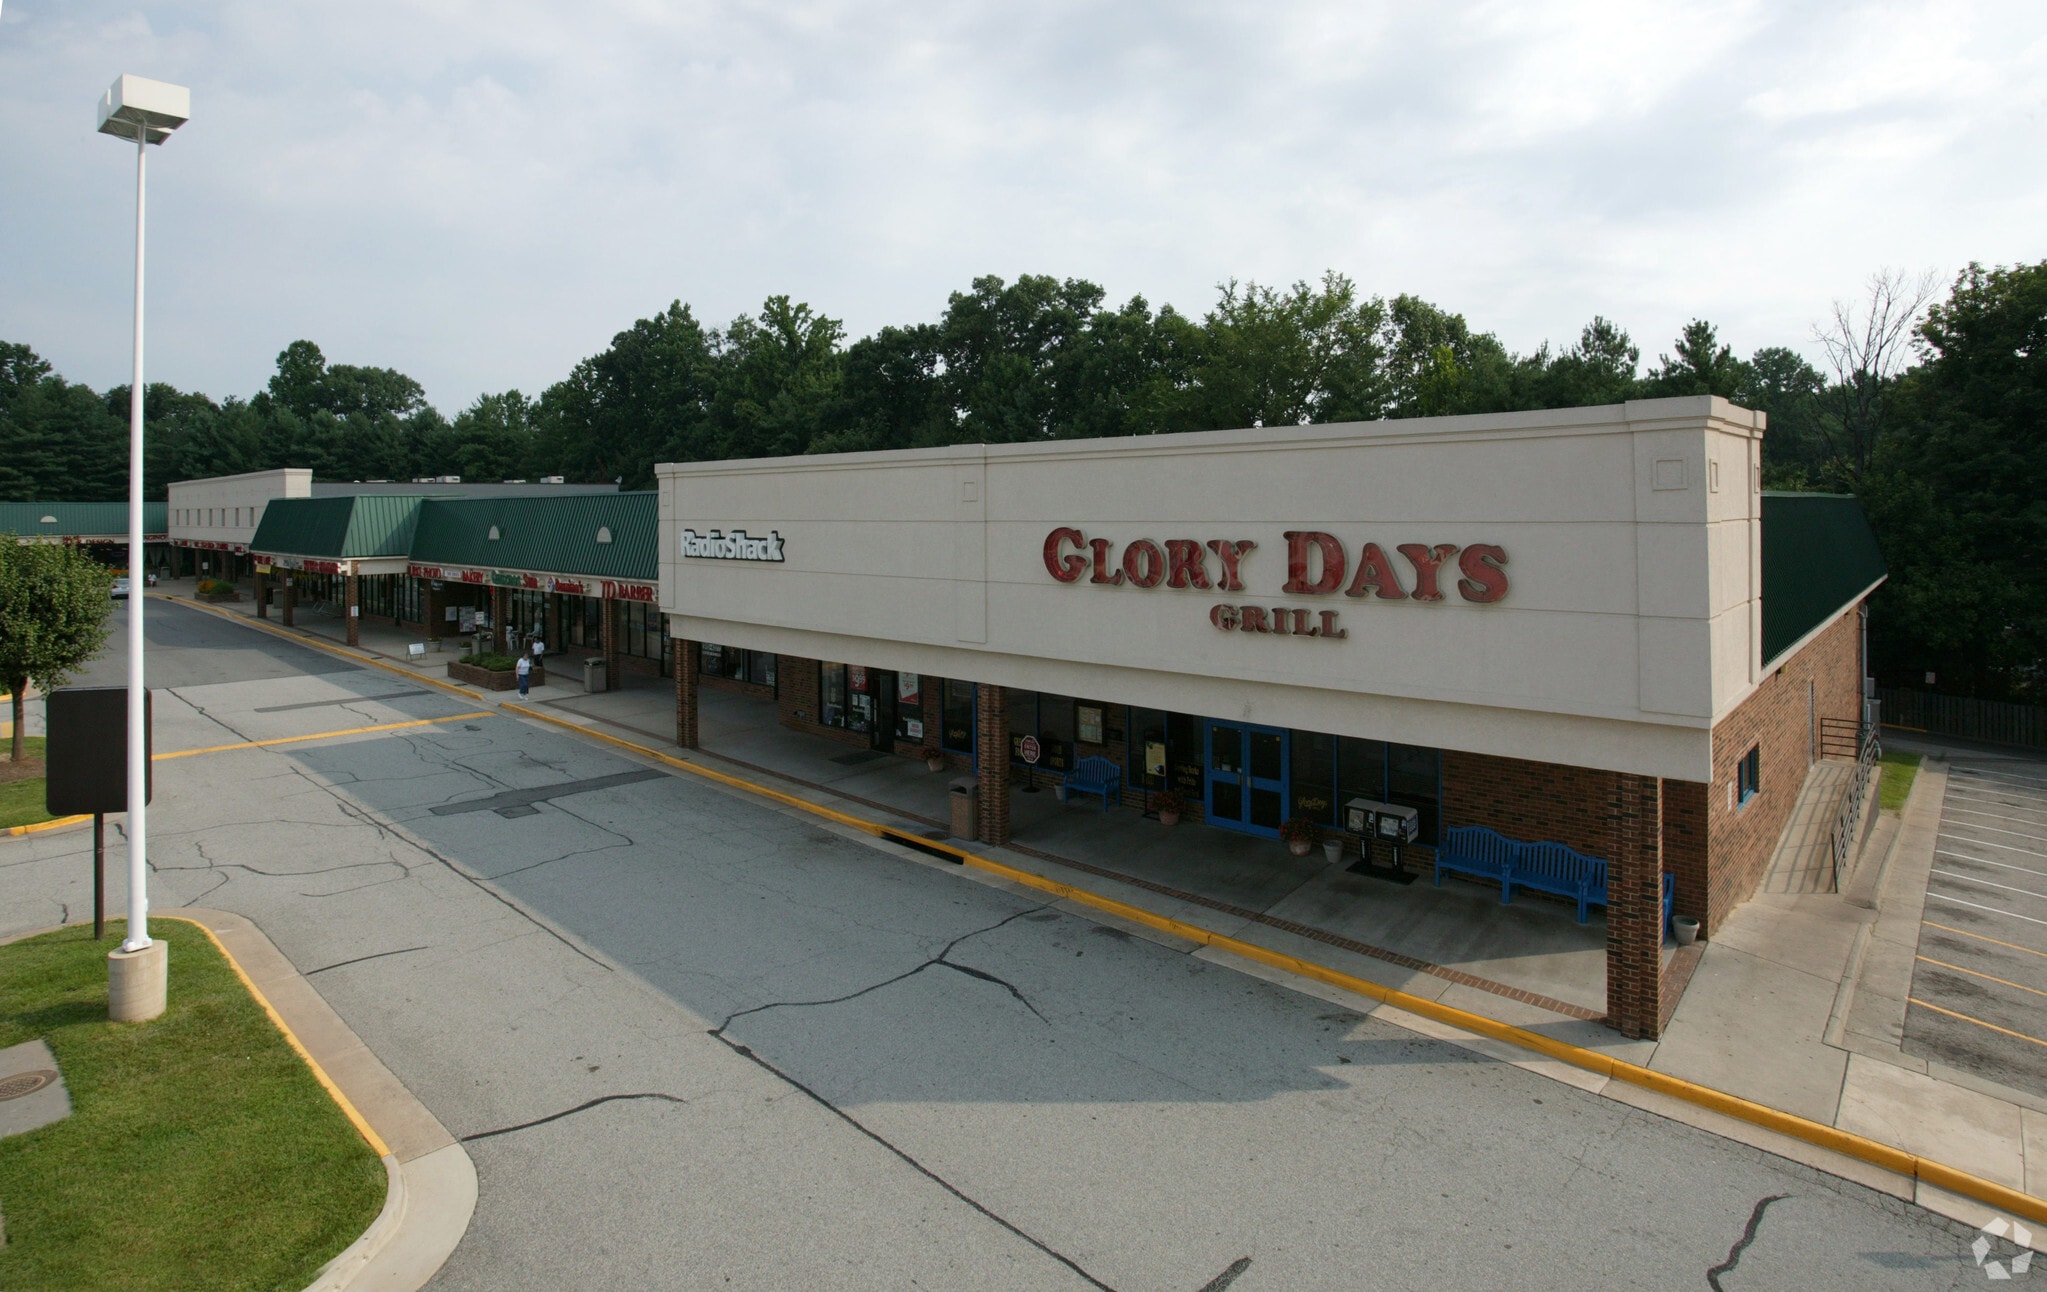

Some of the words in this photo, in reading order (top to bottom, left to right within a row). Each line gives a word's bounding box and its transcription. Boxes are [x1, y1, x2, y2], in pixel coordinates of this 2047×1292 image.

[681, 529, 785, 562] RadioShack
[1043, 527, 1258, 591] GLORY
[1282, 531, 1509, 603] DAYS
[618, 584, 653, 602] BARBER
[1210, 604, 1349, 638] GRILL
